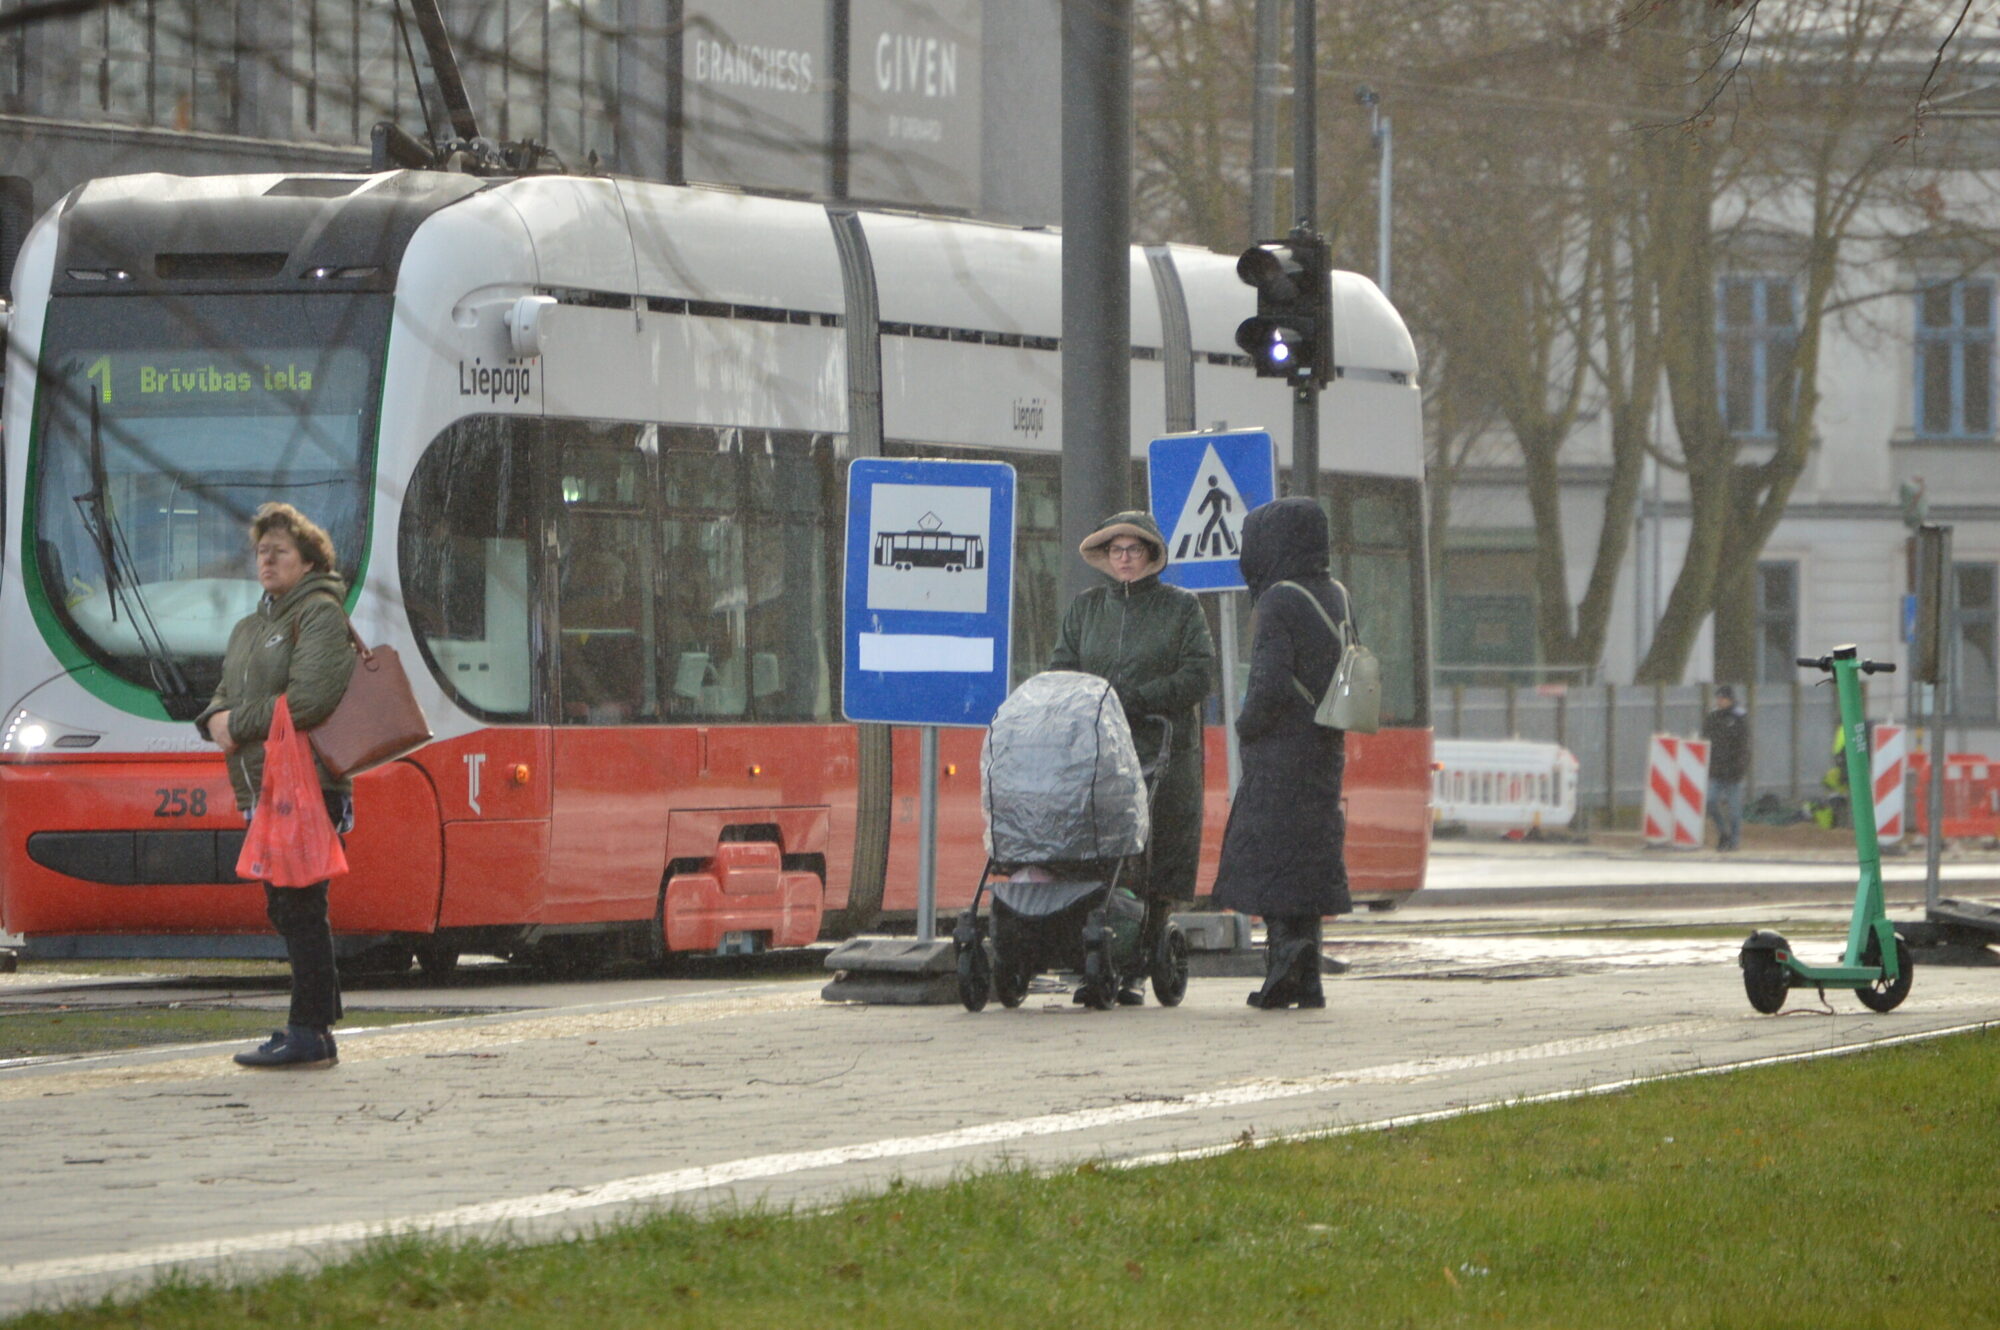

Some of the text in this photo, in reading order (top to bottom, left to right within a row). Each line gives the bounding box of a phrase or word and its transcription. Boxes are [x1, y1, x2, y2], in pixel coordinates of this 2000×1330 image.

[695, 39, 813, 93] BRANCHESS
[875, 32, 957, 96] GIVEN
[87, 355, 313, 404] 1 Brīvības iela
[459, 357, 531, 404] Liepāja
[154, 788, 208, 818] 258
